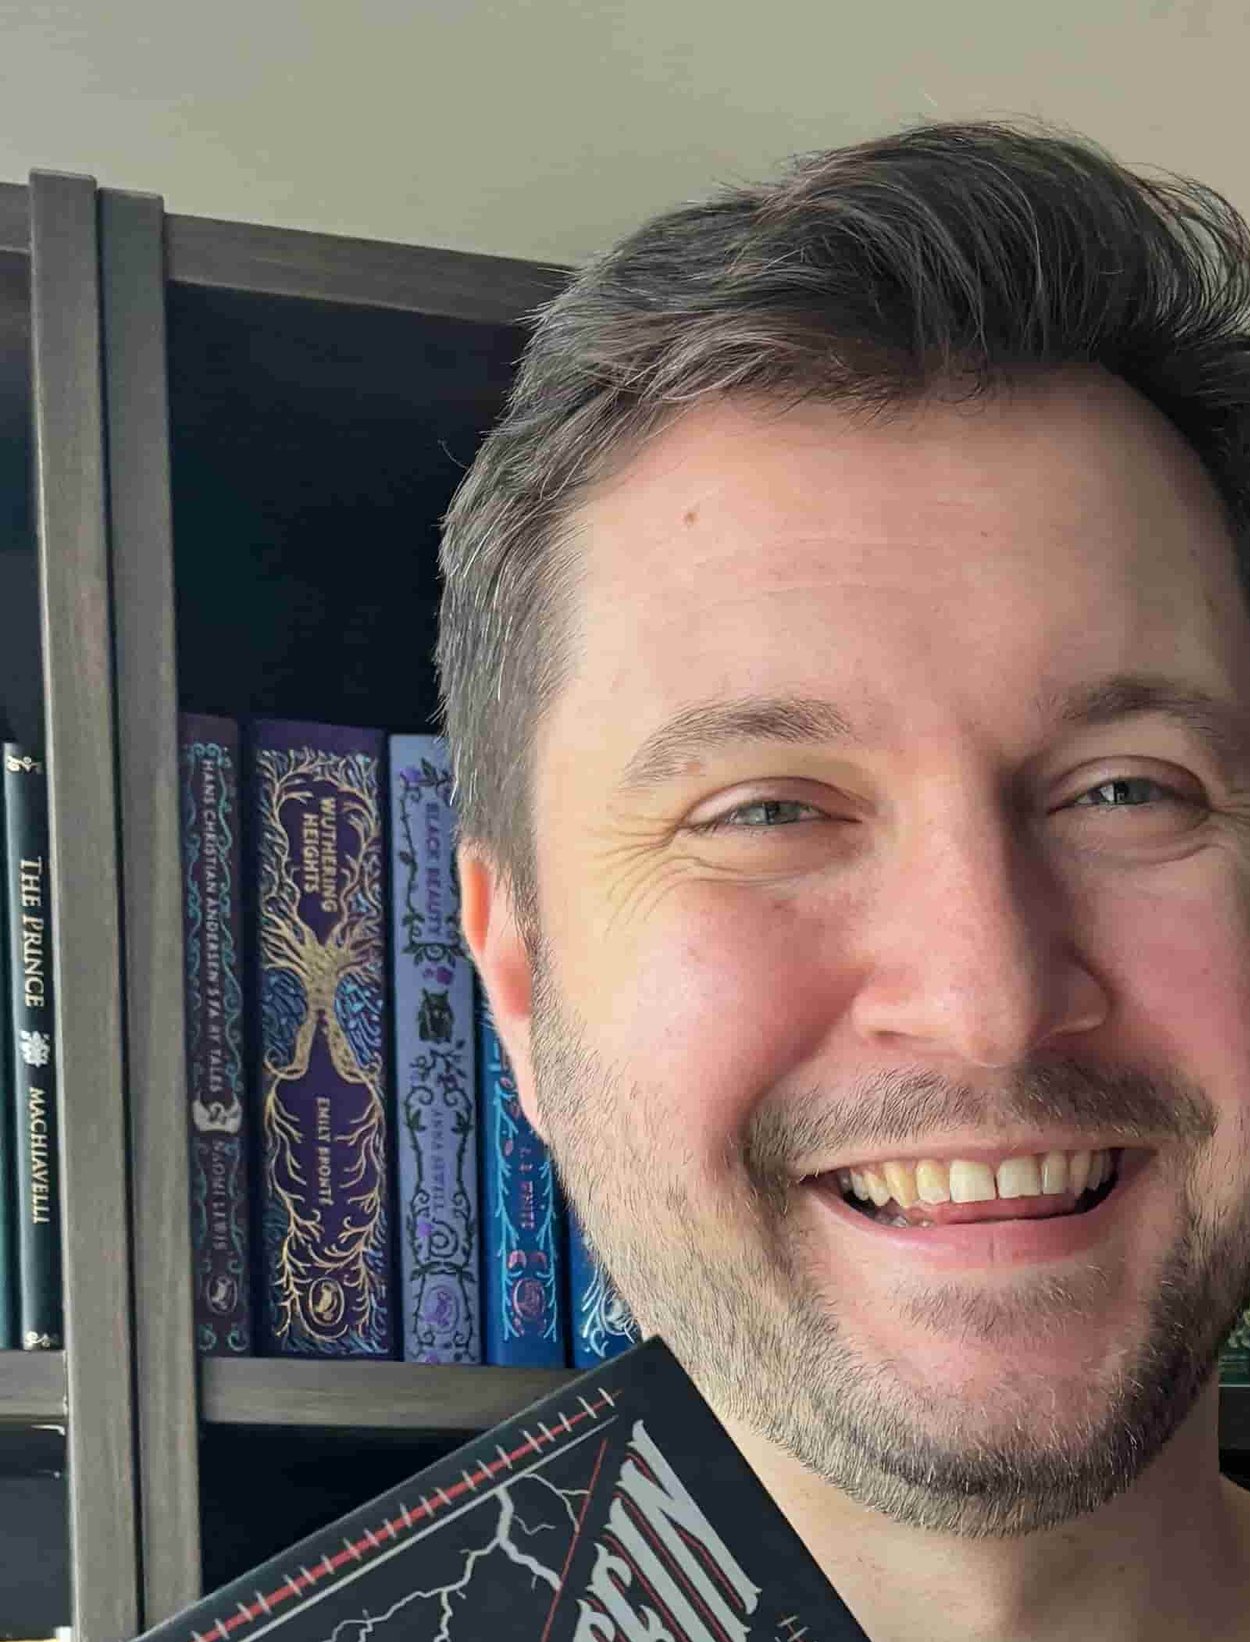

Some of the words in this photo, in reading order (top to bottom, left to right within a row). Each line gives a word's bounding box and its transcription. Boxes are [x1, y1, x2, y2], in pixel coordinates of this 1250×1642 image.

[203, 759, 216, 804] HANS
[204, 810, 218, 893] CHRISTIAN
[303, 813, 320, 894] HEIGHTS
[321, 797, 338, 912] WUTHERING
[426, 802, 441, 861] BLACK
[21, 857, 43, 907] THE
[427, 867, 443, 936] BEAUTY
[22, 914, 46, 1008] PRINCE
[209, 999, 222, 1044] FARY
[209, 1049, 223, 1092] TALES
[316, 1097, 331, 1142] EMILY
[29, 1086, 51, 1226] MACHIAVELLI
